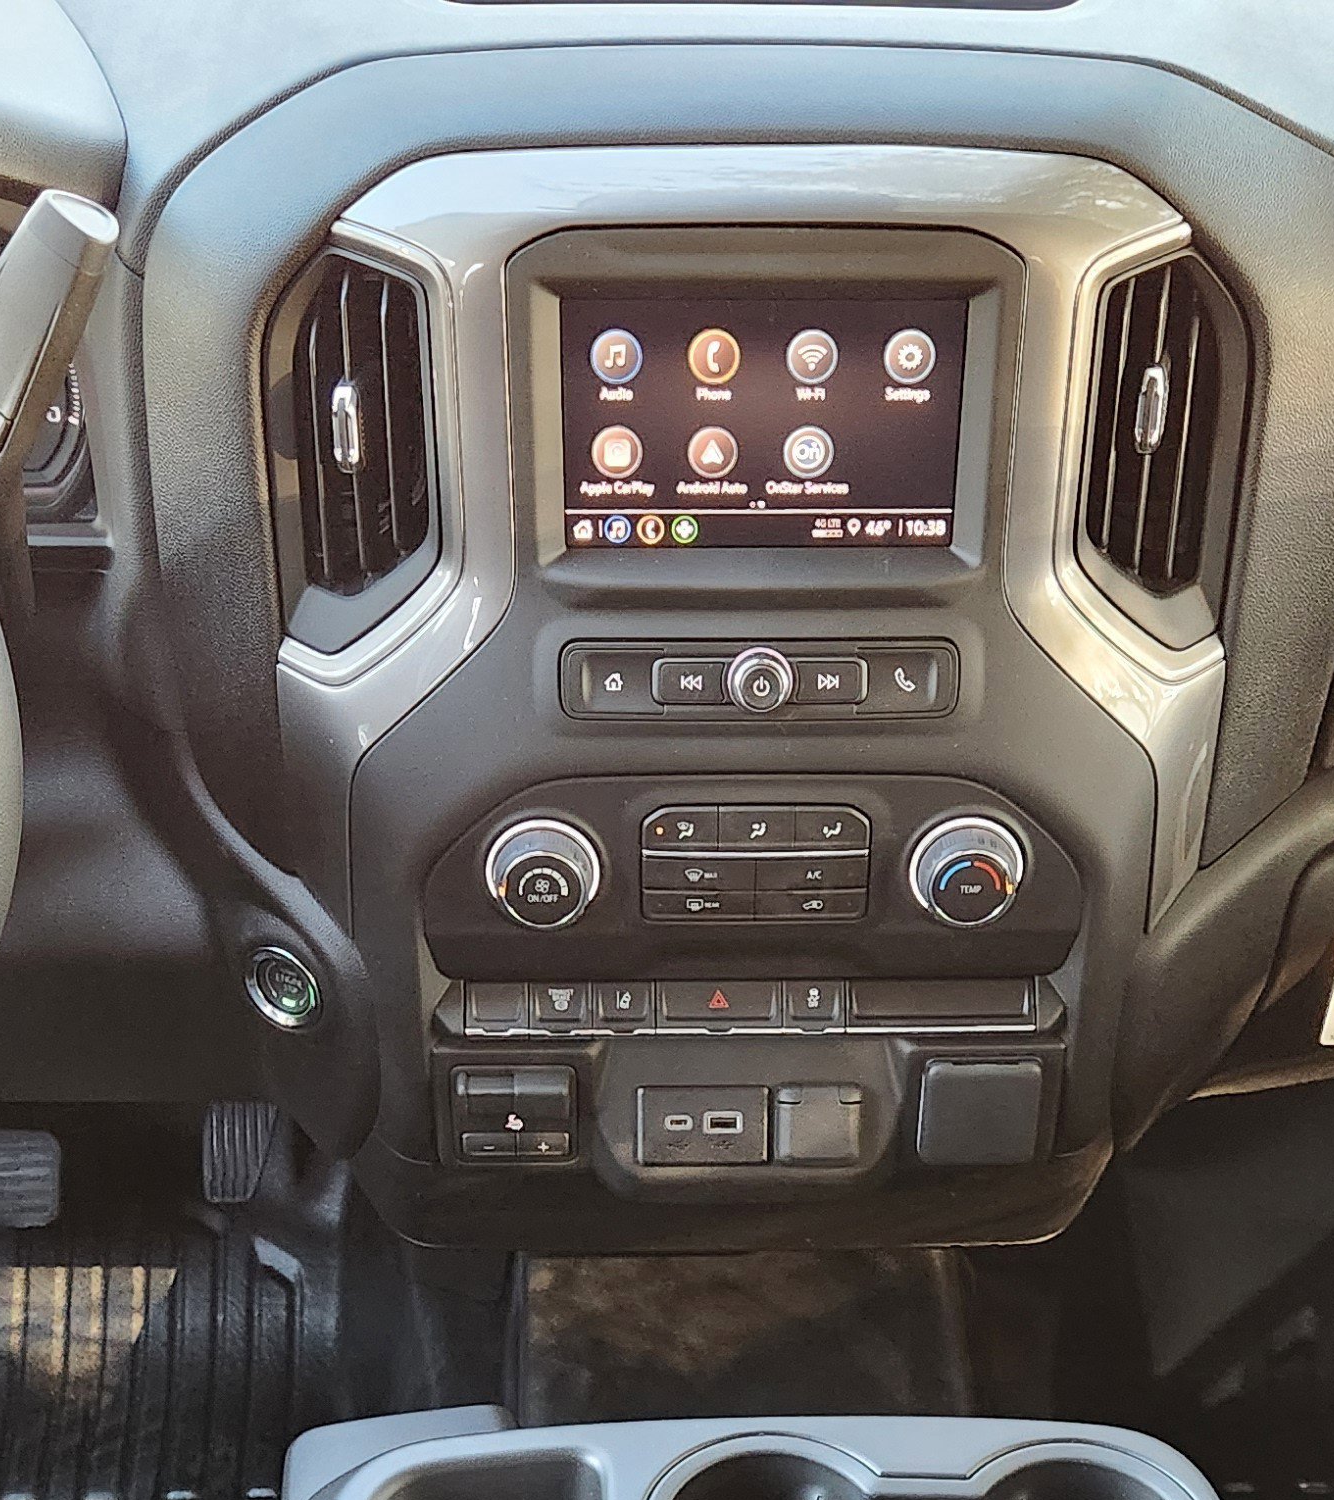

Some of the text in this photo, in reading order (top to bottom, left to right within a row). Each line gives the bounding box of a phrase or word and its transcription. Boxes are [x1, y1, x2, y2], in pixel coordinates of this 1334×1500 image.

[599, 386, 634, 401] Audio
[696, 386, 732, 401] Phone
[795, 386, 826, 401] Wi-Fi
[885, 386, 931, 404] Settings
[579, 481, 655, 497] Apple CarPlay
[676, 481, 748, 495] Android Auto
[765, 480, 850, 495] OnStar Services
[806, 870, 822, 880] A/C
[960, 885, 982, 894] TEMP
[527, 893, 559, 903] ON/OFF
